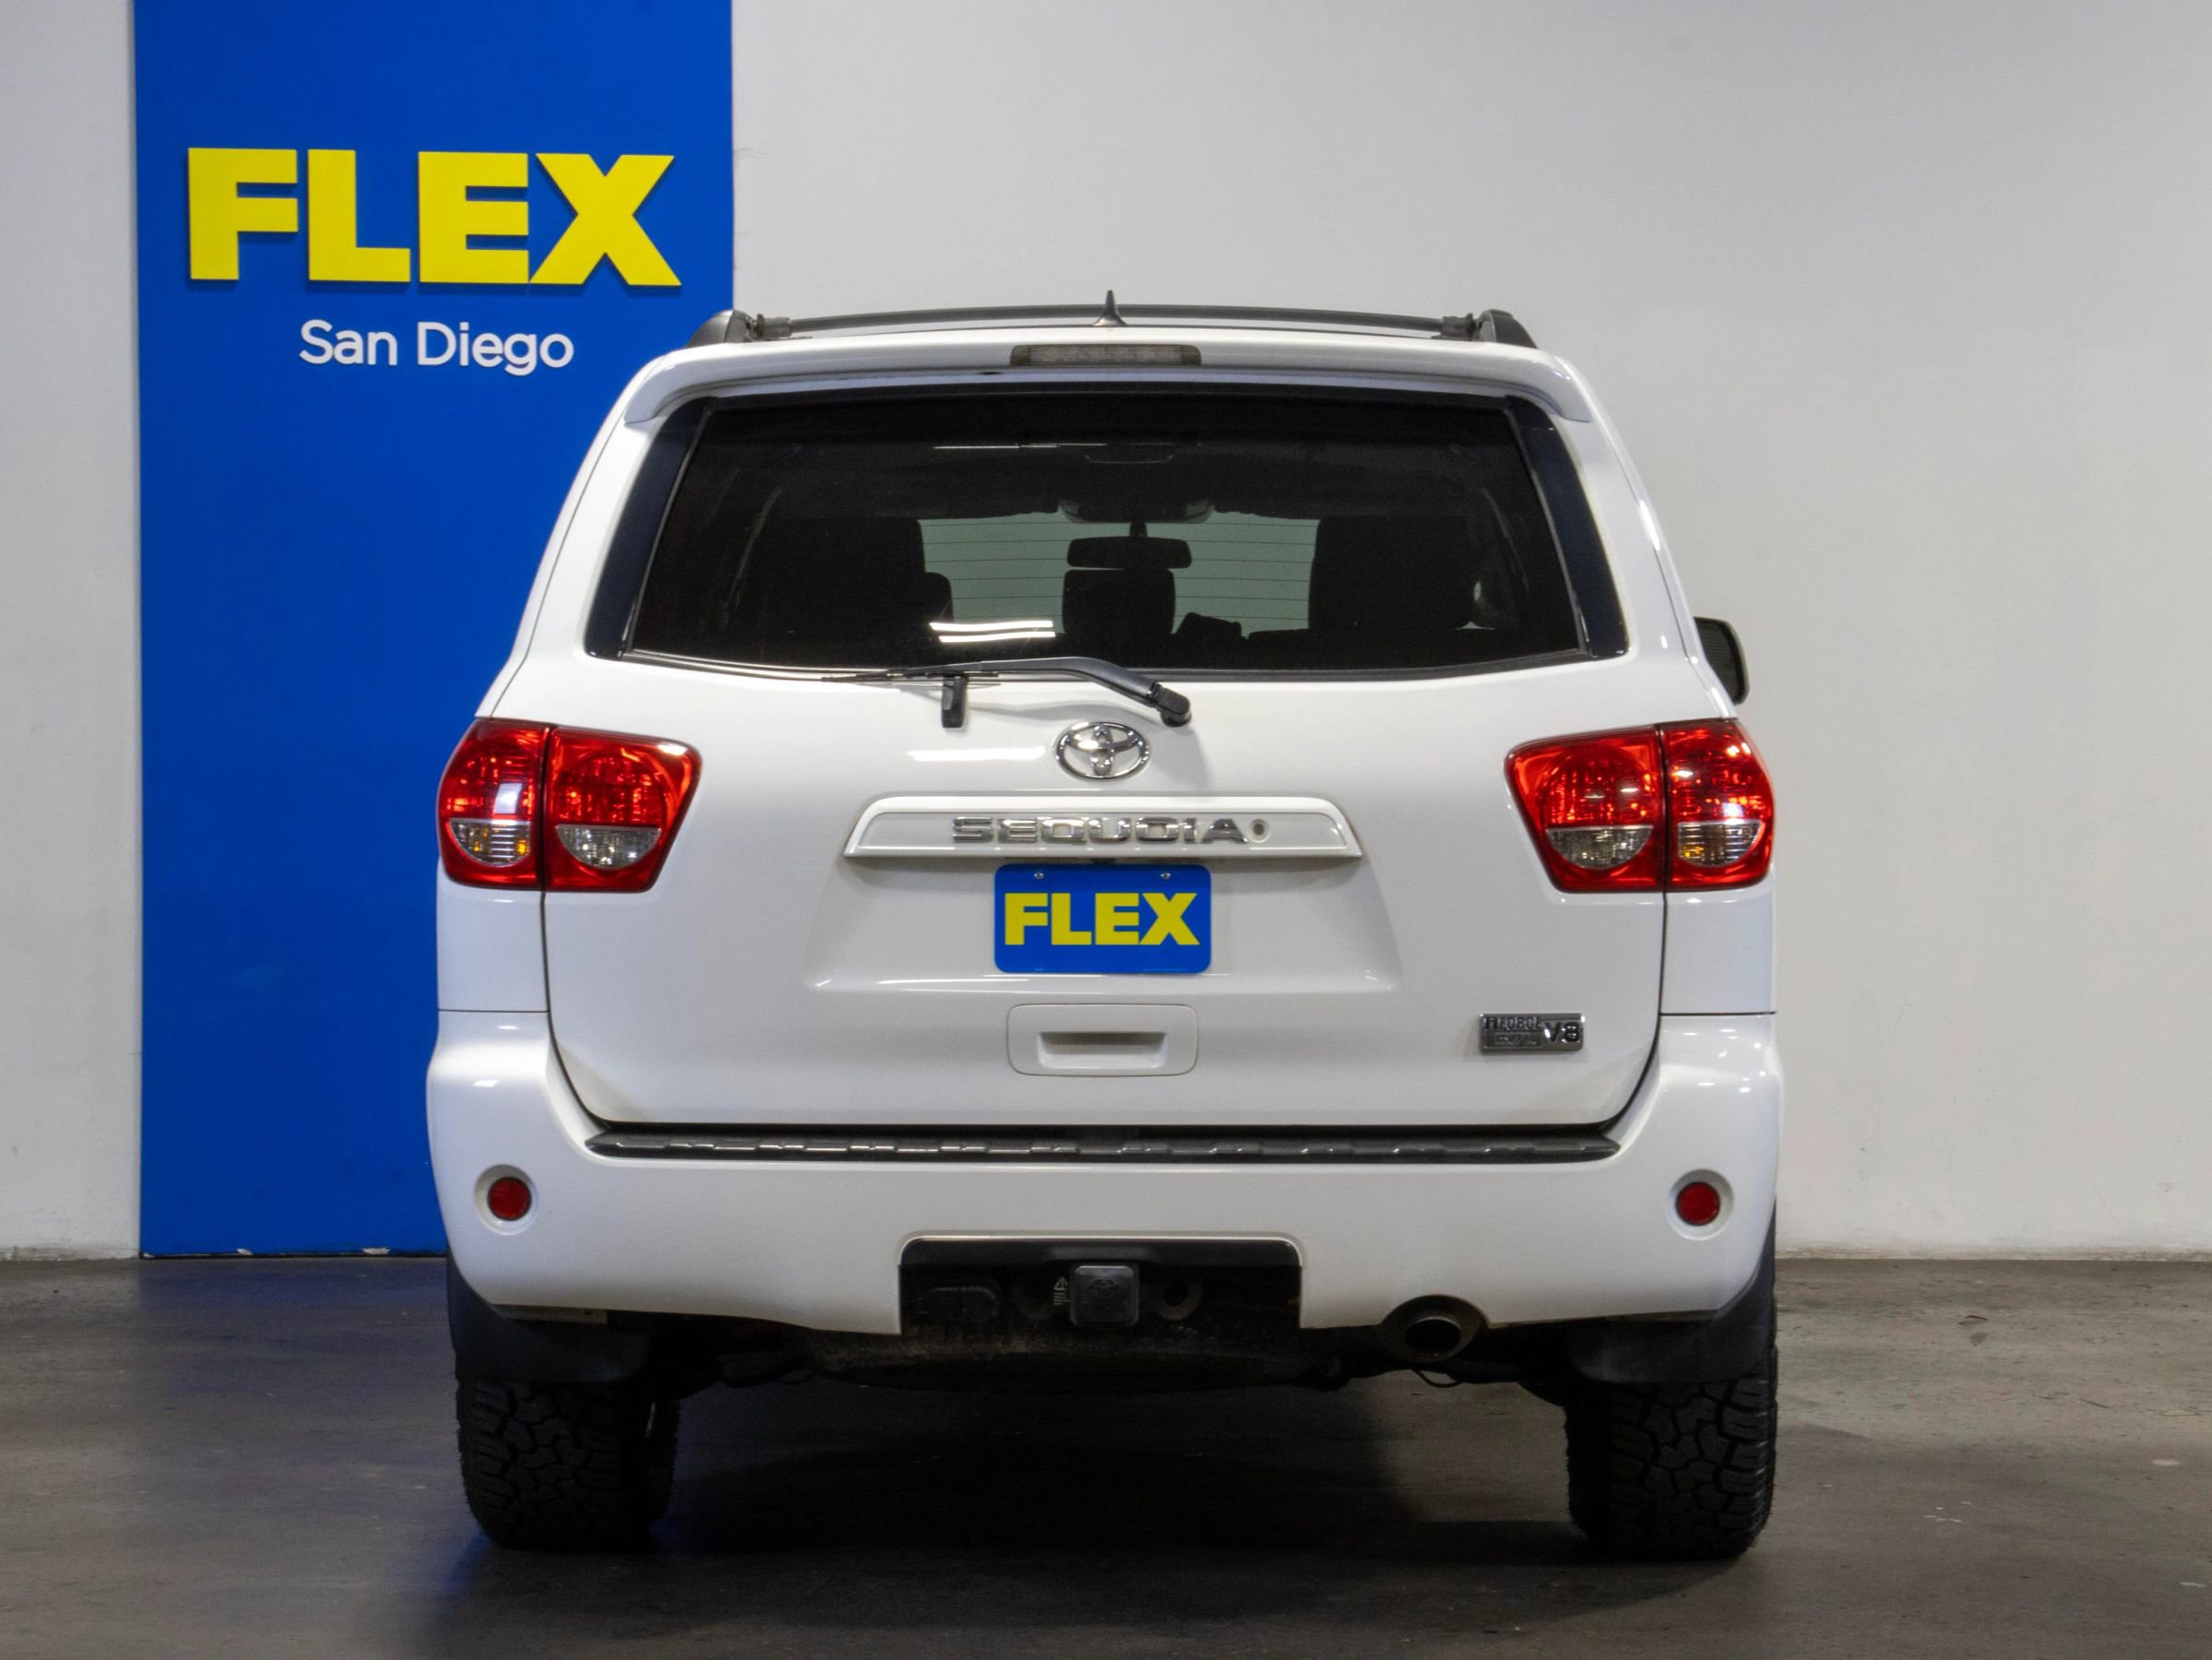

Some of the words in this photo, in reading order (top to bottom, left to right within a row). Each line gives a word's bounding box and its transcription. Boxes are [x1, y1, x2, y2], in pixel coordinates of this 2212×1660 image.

[187, 147, 682, 287] FLEX
[299, 318, 398, 365] San
[417, 321, 574, 376] Diego
[953, 816, 1248, 844] SEQUOIA
[1005, 892, 1199, 945] FLEX
[1543, 1021, 1580, 1043] V8
